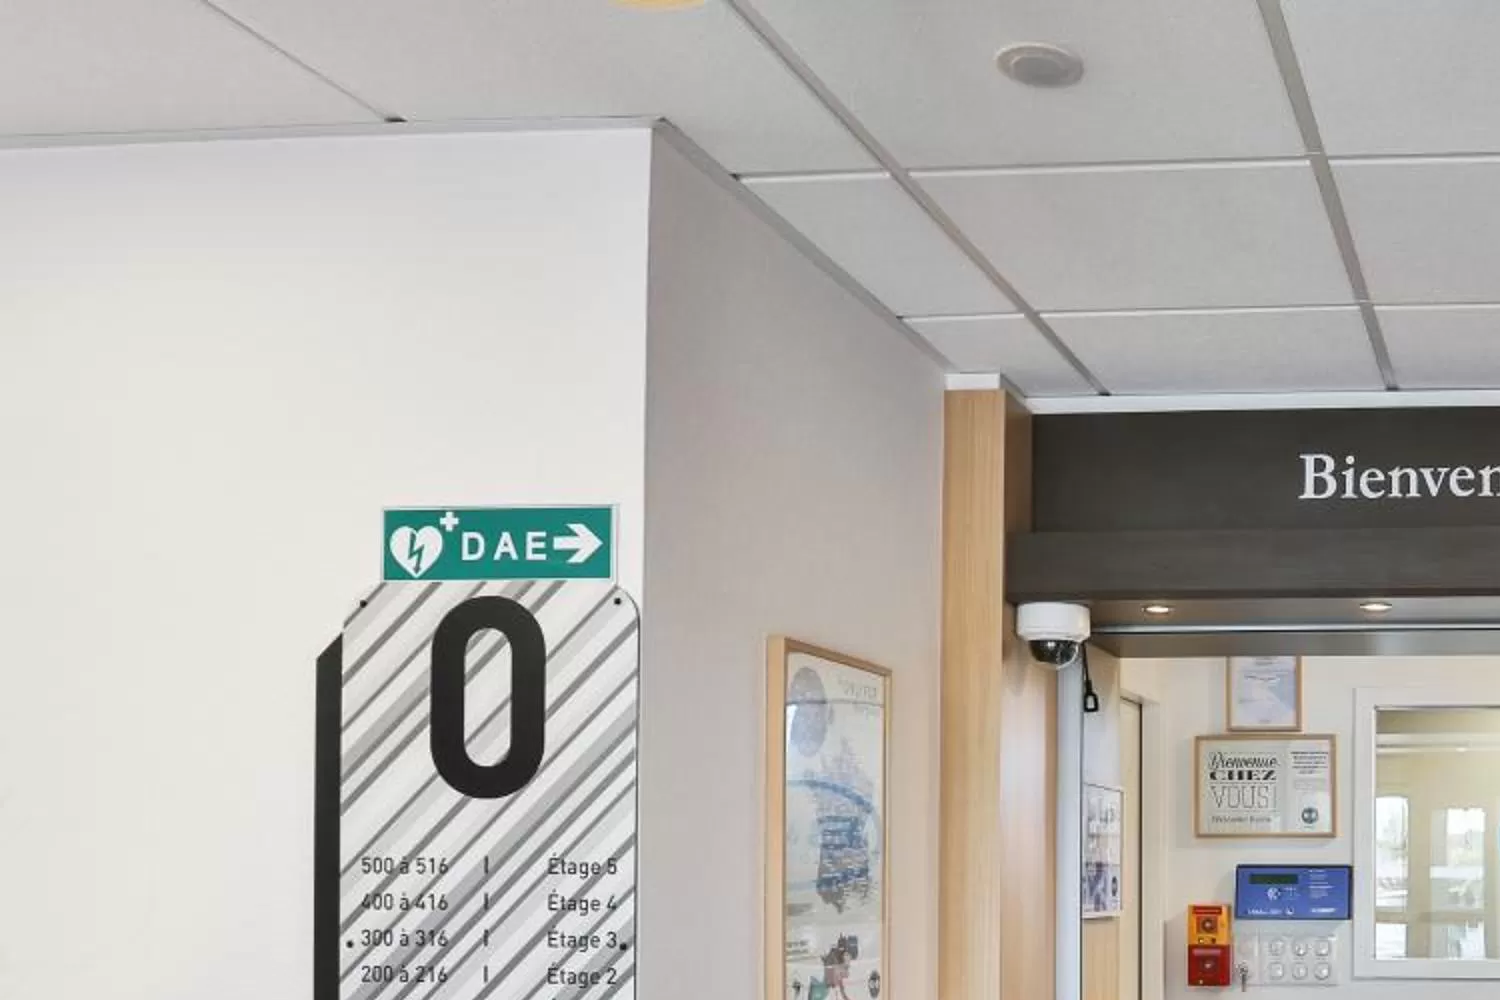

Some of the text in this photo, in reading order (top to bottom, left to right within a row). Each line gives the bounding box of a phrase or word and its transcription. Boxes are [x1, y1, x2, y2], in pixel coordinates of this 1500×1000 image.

[461, 531, 548, 561] DAE
[1209, 770, 1277, 781] CHEZ
[361, 856, 449, 875] 500 à 516
[547, 852, 617, 879] Étage 5
[361, 892, 449, 911] 400 à 416
[547, 888, 617, 916] Étage 4
[361, 928, 449, 947] 300 à 316
[547, 924, 617, 952] Étage 3
[361, 965, 449, 983] 200 à 216
[547, 962, 617, 989] Étage 2
